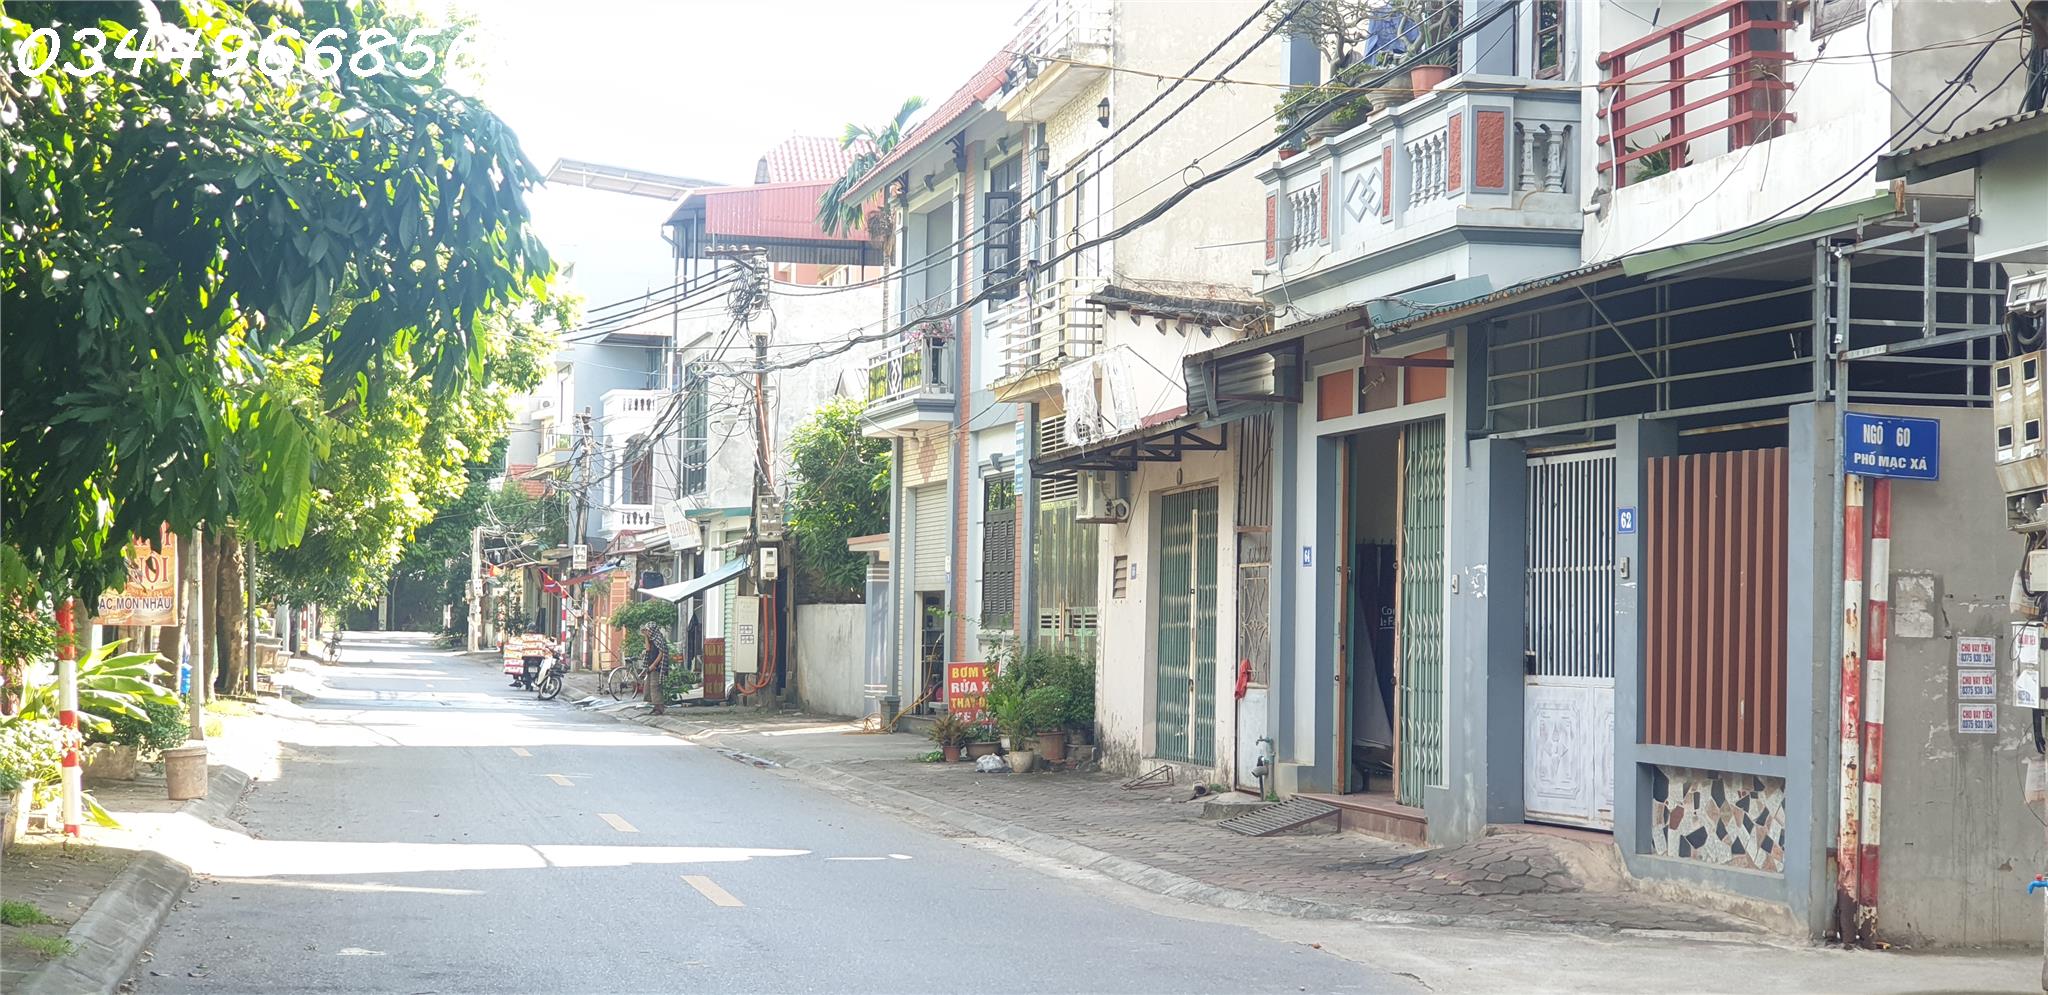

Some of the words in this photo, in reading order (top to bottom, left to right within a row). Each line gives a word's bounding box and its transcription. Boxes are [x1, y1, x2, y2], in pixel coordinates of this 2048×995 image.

[1863, 421, 1884, 445] NGÕ
[1896, 427, 1911, 447] 60
[1853, 451, 1877, 466] PHỐ
[1878, 455, 1907, 470] MẠC
[1620, 511, 1632, 529] 62
[952, 666, 978, 678] BƠM
[951, 679, 978, 693] RỬA
